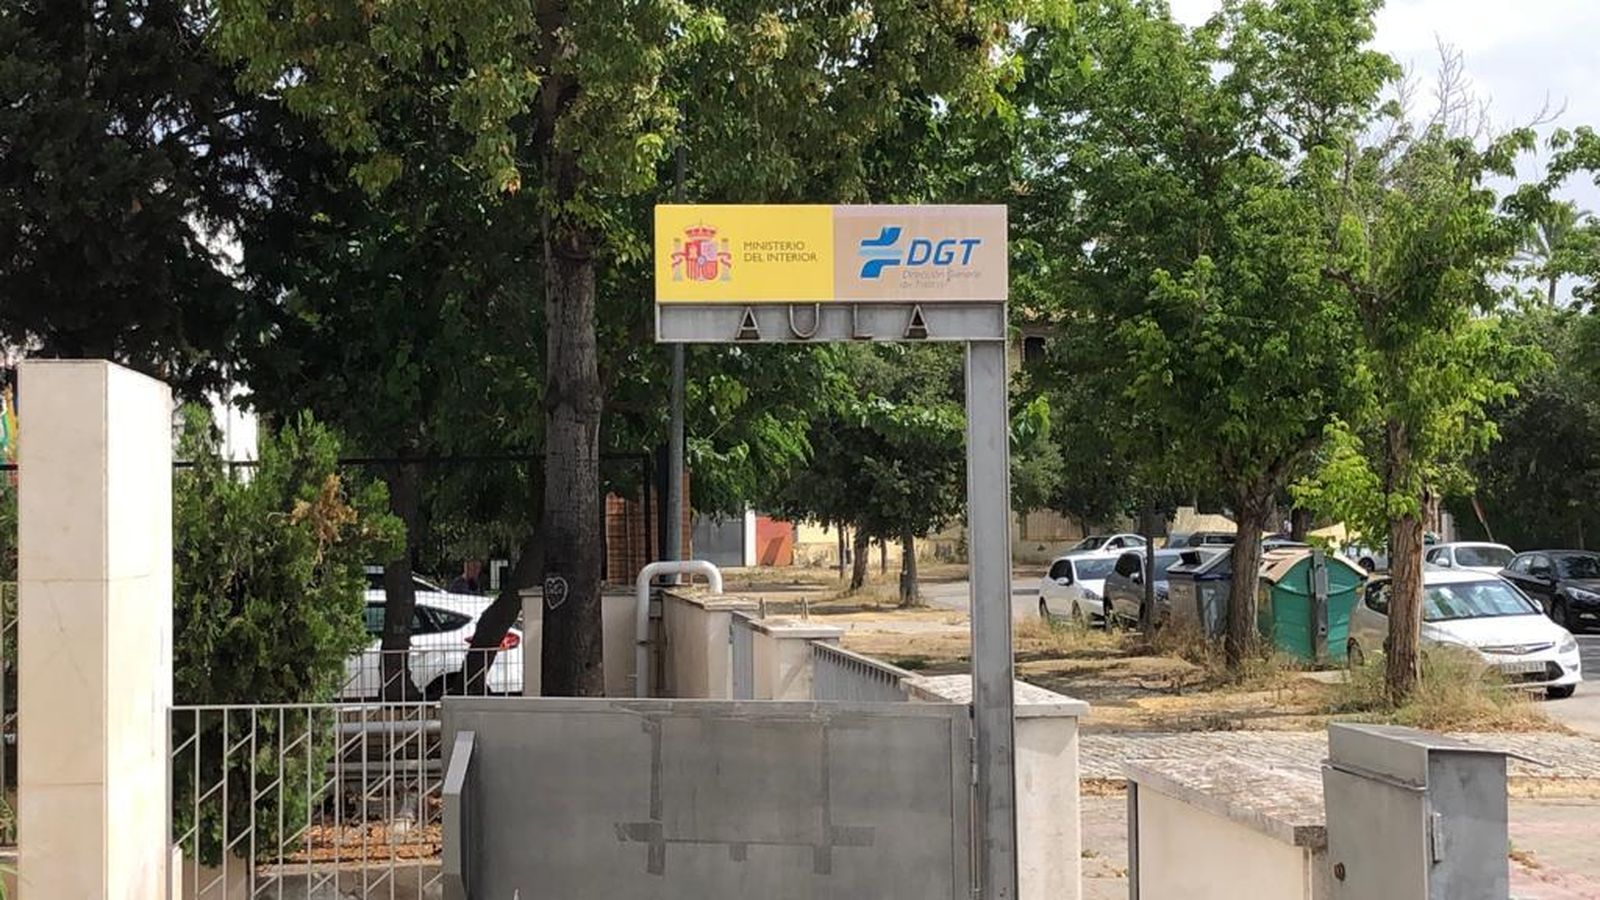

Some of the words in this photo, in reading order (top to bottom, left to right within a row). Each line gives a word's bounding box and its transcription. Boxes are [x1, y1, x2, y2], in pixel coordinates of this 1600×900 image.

[743, 241, 805, 251] MINISTERIO
[907, 239, 981, 265] DGT
[743, 253, 762, 262] DEL
[766, 253, 818, 262] INTERIOR
[734, 302, 930, 341] AULA
